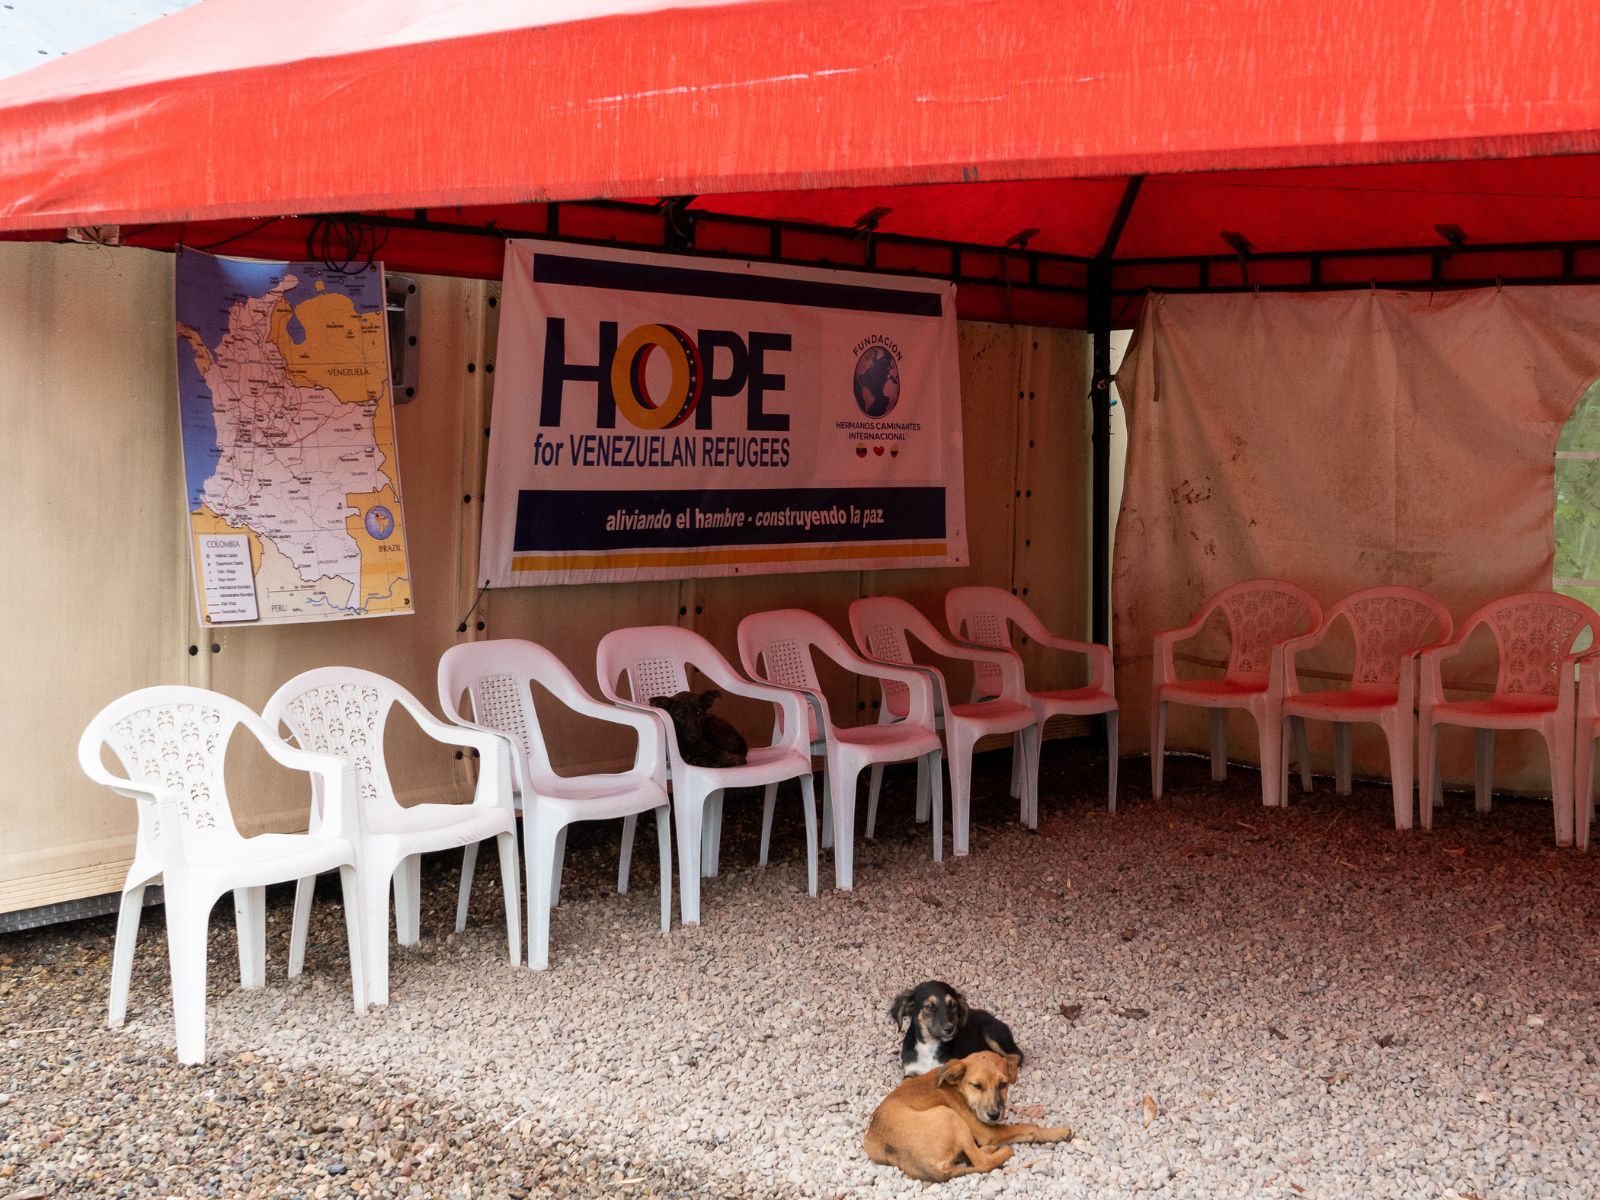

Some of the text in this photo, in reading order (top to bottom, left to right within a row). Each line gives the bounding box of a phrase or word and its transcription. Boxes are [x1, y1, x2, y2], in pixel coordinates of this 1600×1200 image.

[328, 368, 370, 376] VENEZUELA
[539, 317, 792, 431] HOPE
[836, 422, 874, 430] HERMANOS
[534, 434, 790, 468] for VENEZUELAN REFUGEES
[606, 509, 671, 531] aliviando
[676, 509, 690, 529] el
[695, 508, 745, 528] hambre
[755, 505, 846, 530] construyendo
[850, 505, 860, 524] la
[863, 507, 884, 528] paz
